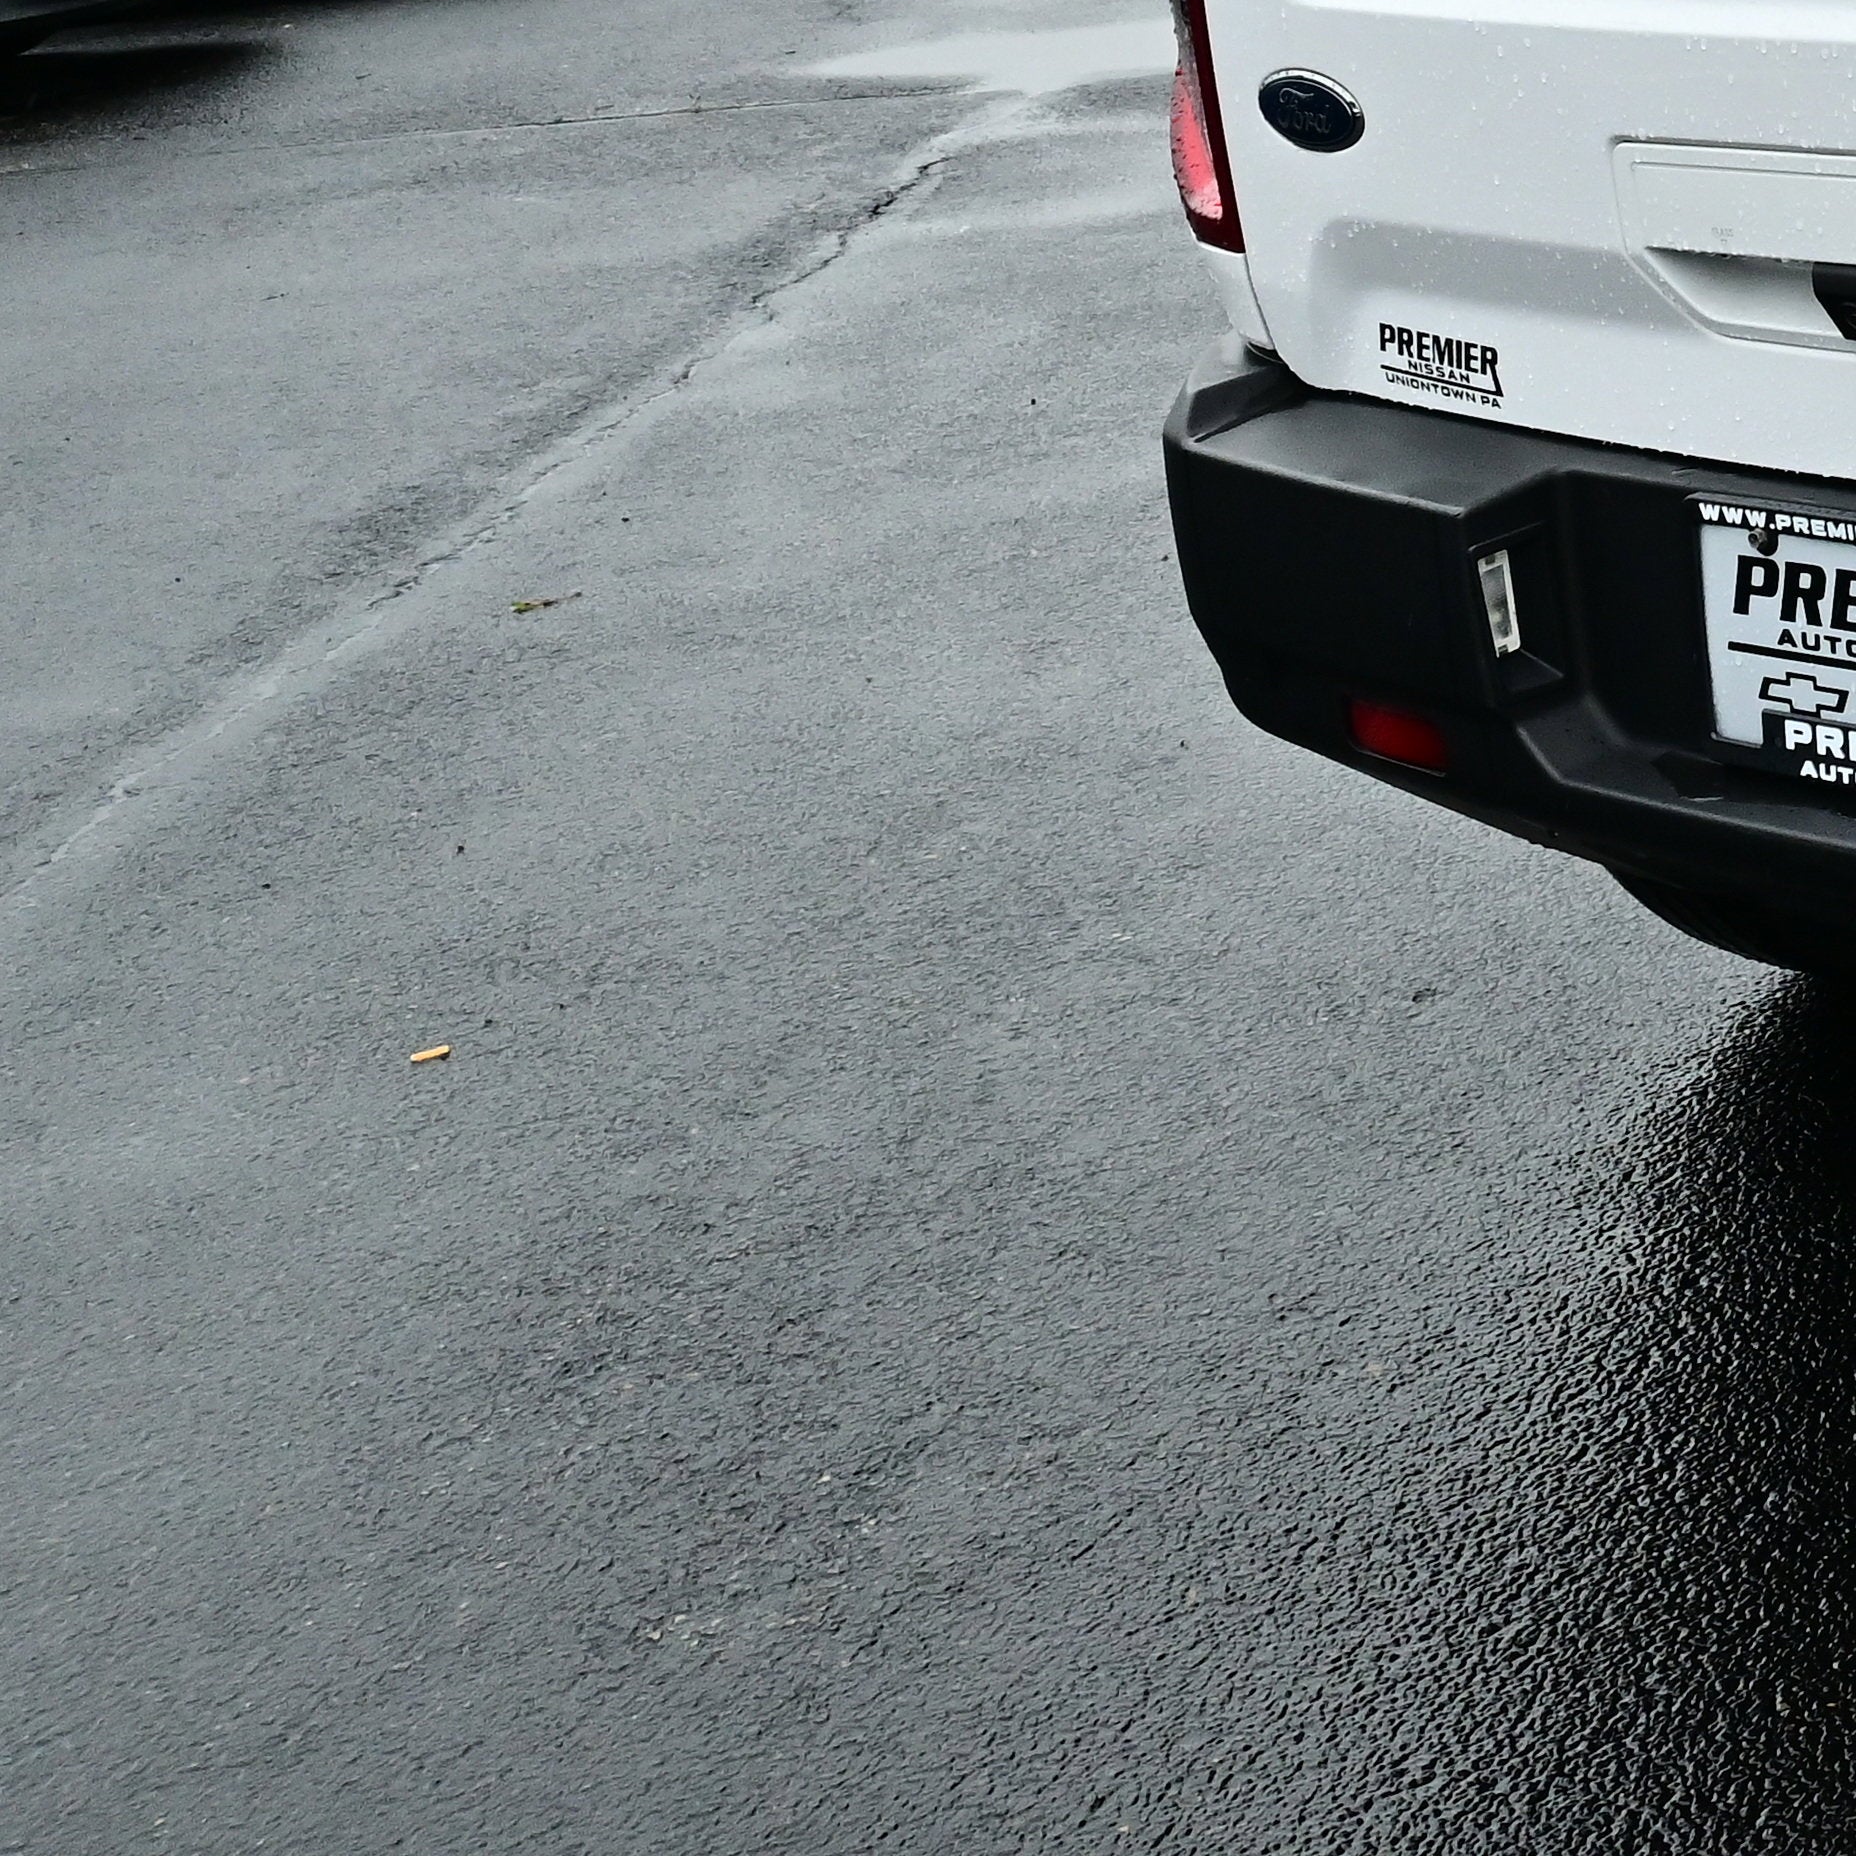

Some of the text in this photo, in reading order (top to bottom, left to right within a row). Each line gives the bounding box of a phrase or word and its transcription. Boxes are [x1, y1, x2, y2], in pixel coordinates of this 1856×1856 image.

[1277, 87, 1332, 134] Ford
[1379, 322, 1501, 384] PREMIER
[1407, 359, 1471, 384] NISSAN
[1385, 372, 1502, 409] UNIONTOWN PA
